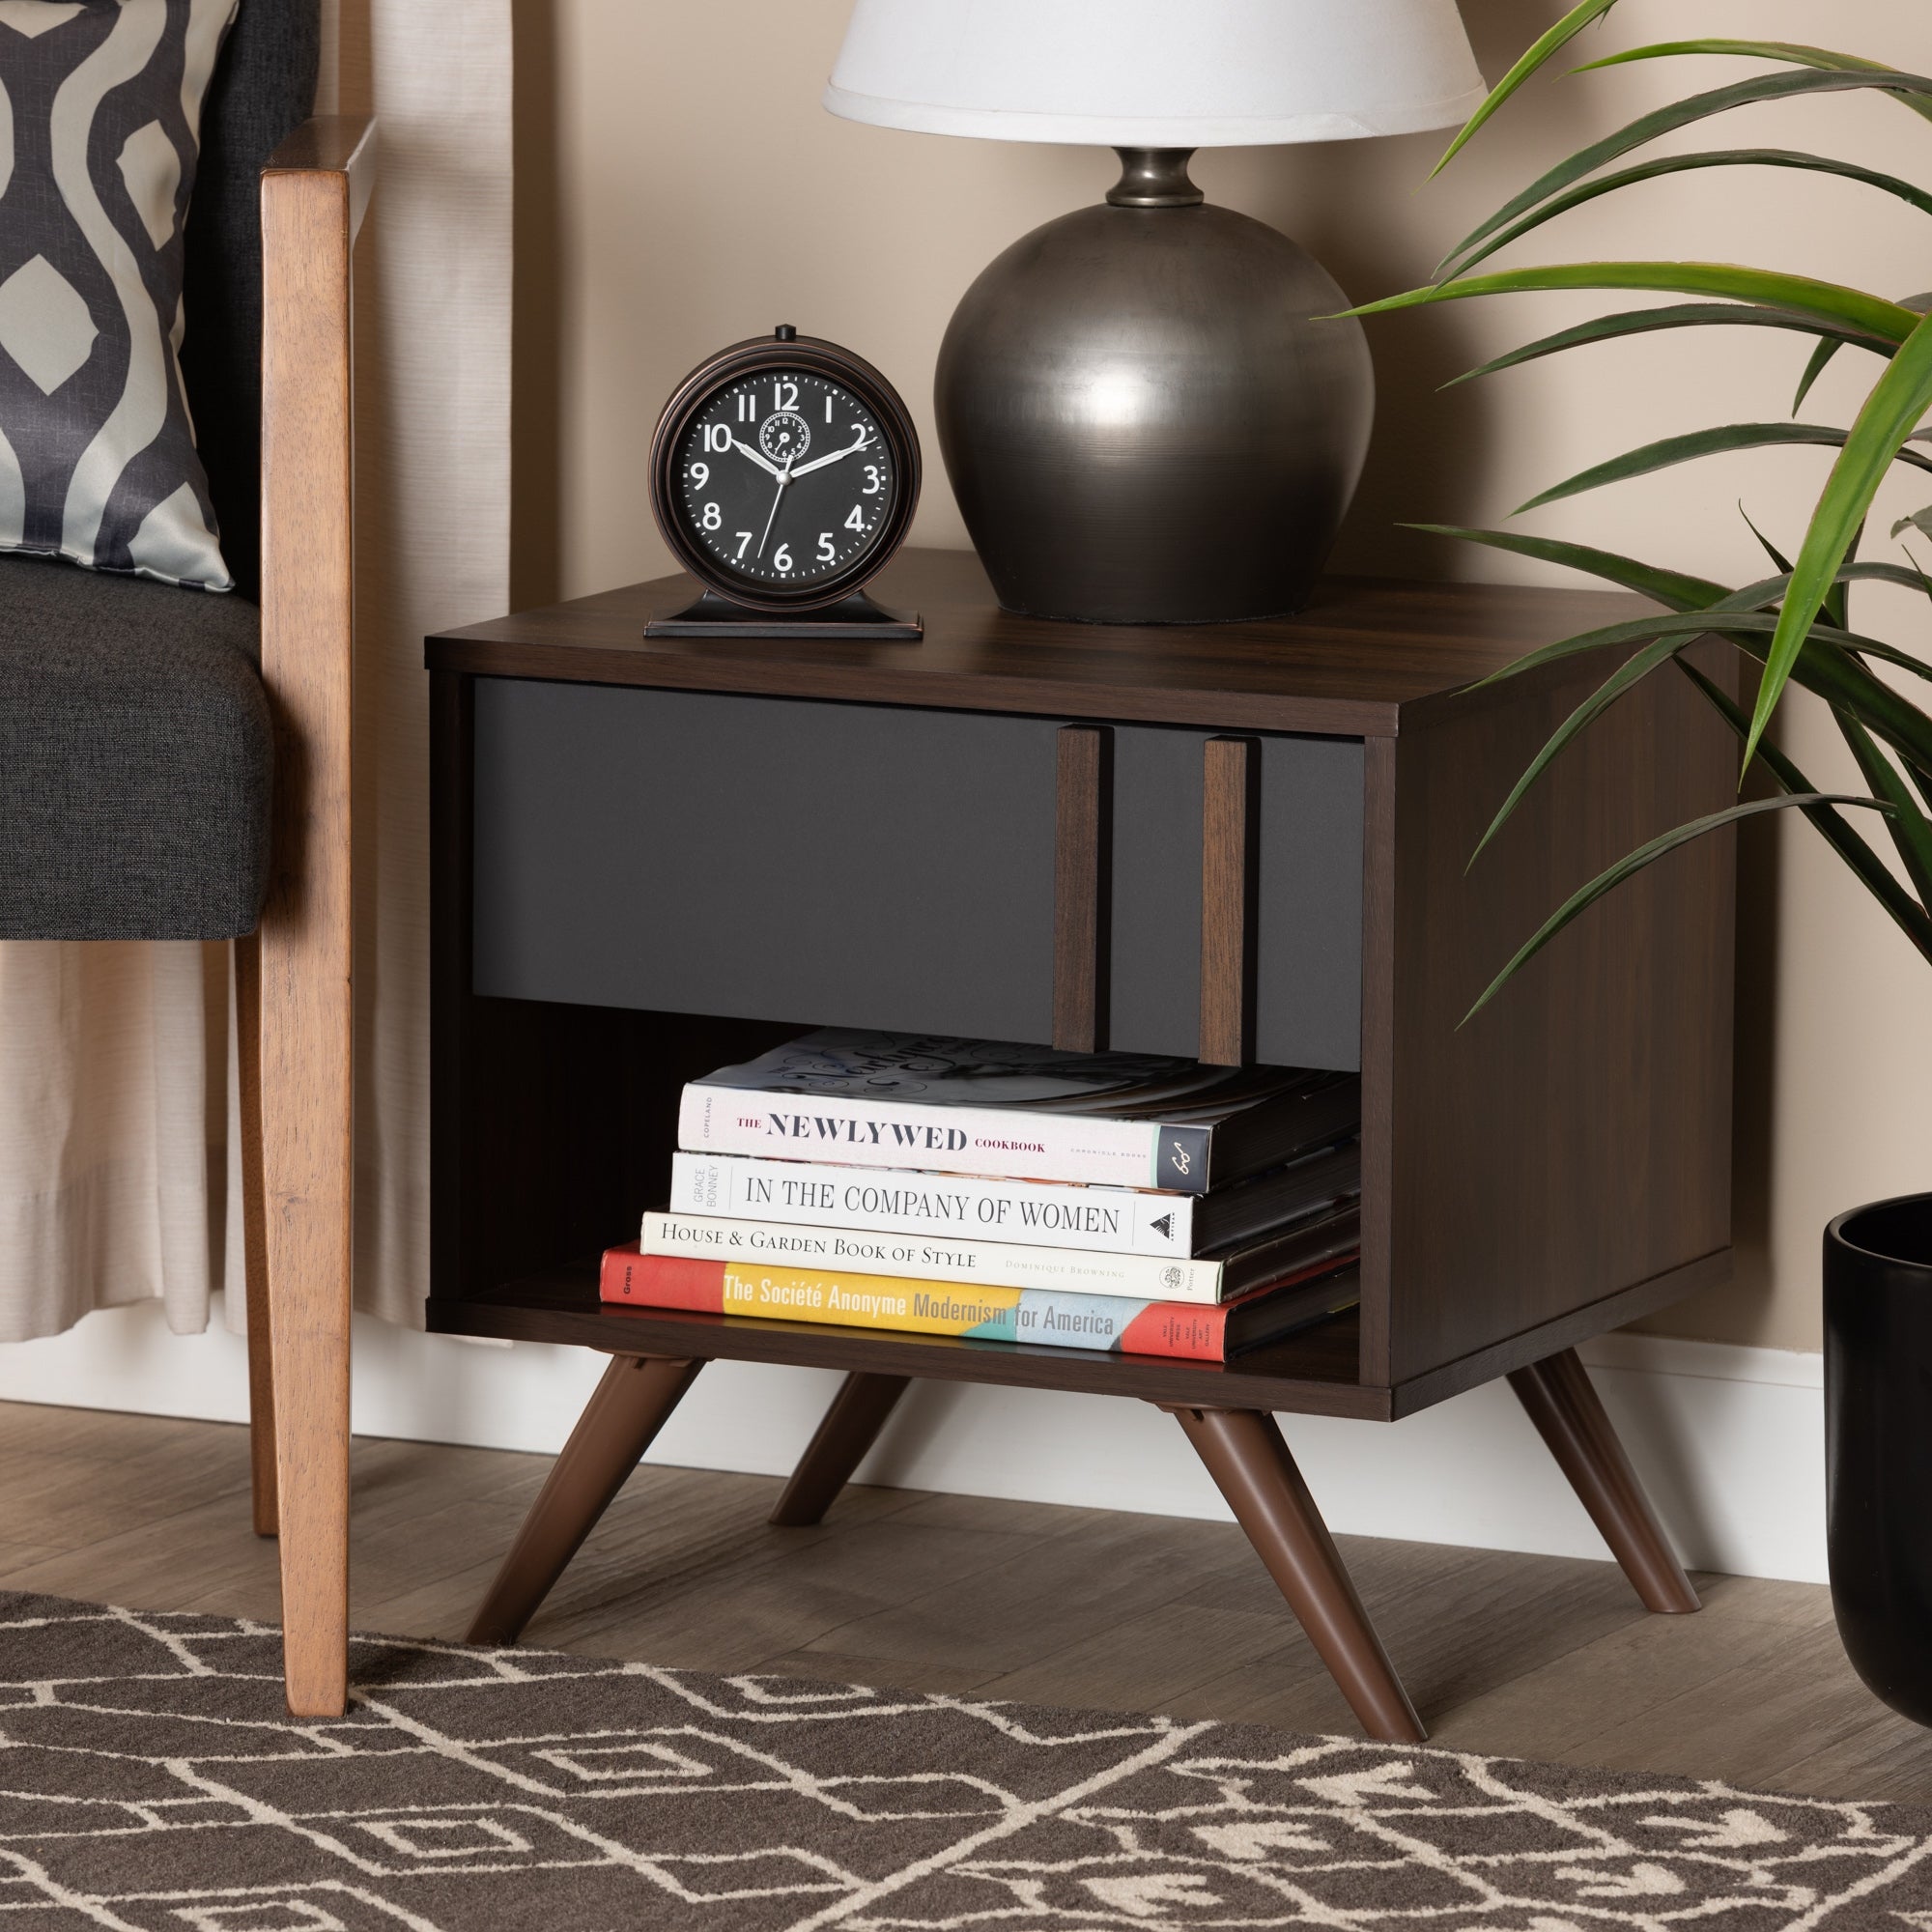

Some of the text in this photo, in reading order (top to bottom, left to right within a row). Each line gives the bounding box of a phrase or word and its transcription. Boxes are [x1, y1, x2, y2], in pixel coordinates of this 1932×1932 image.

[738, 394, 755, 421] 11
[774, 383, 799, 411] 12
[826, 396, 832, 423] 1
[704, 423, 732, 452] 10
[851, 423, 867, 451] 2
[690, 463, 709, 491] 9
[863, 466, 880, 494] 3
[702, 502, 722, 530] 8
[843, 504, 865, 531] 4
[735, 532, 753, 558] 7
[774, 543, 793, 572] 6
[816, 533, 835, 561] 5
[737, 1113, 1045, 1153] THE NEWLYWED COOKBOOK
[694, 1168, 705, 1202] GRACE
[706, 1165, 719, 1208] BONNEY
[746, 1178, 1121, 1234] IN THE COMPANY OF WOMEN
[729, 1231, 744, 1246] &
[623, 1265, 632, 1294] Gross
[1186, 1267, 1195, 1291] Potter
[724, 1274, 1114, 1335] The Société Anonyme Modernism for America
